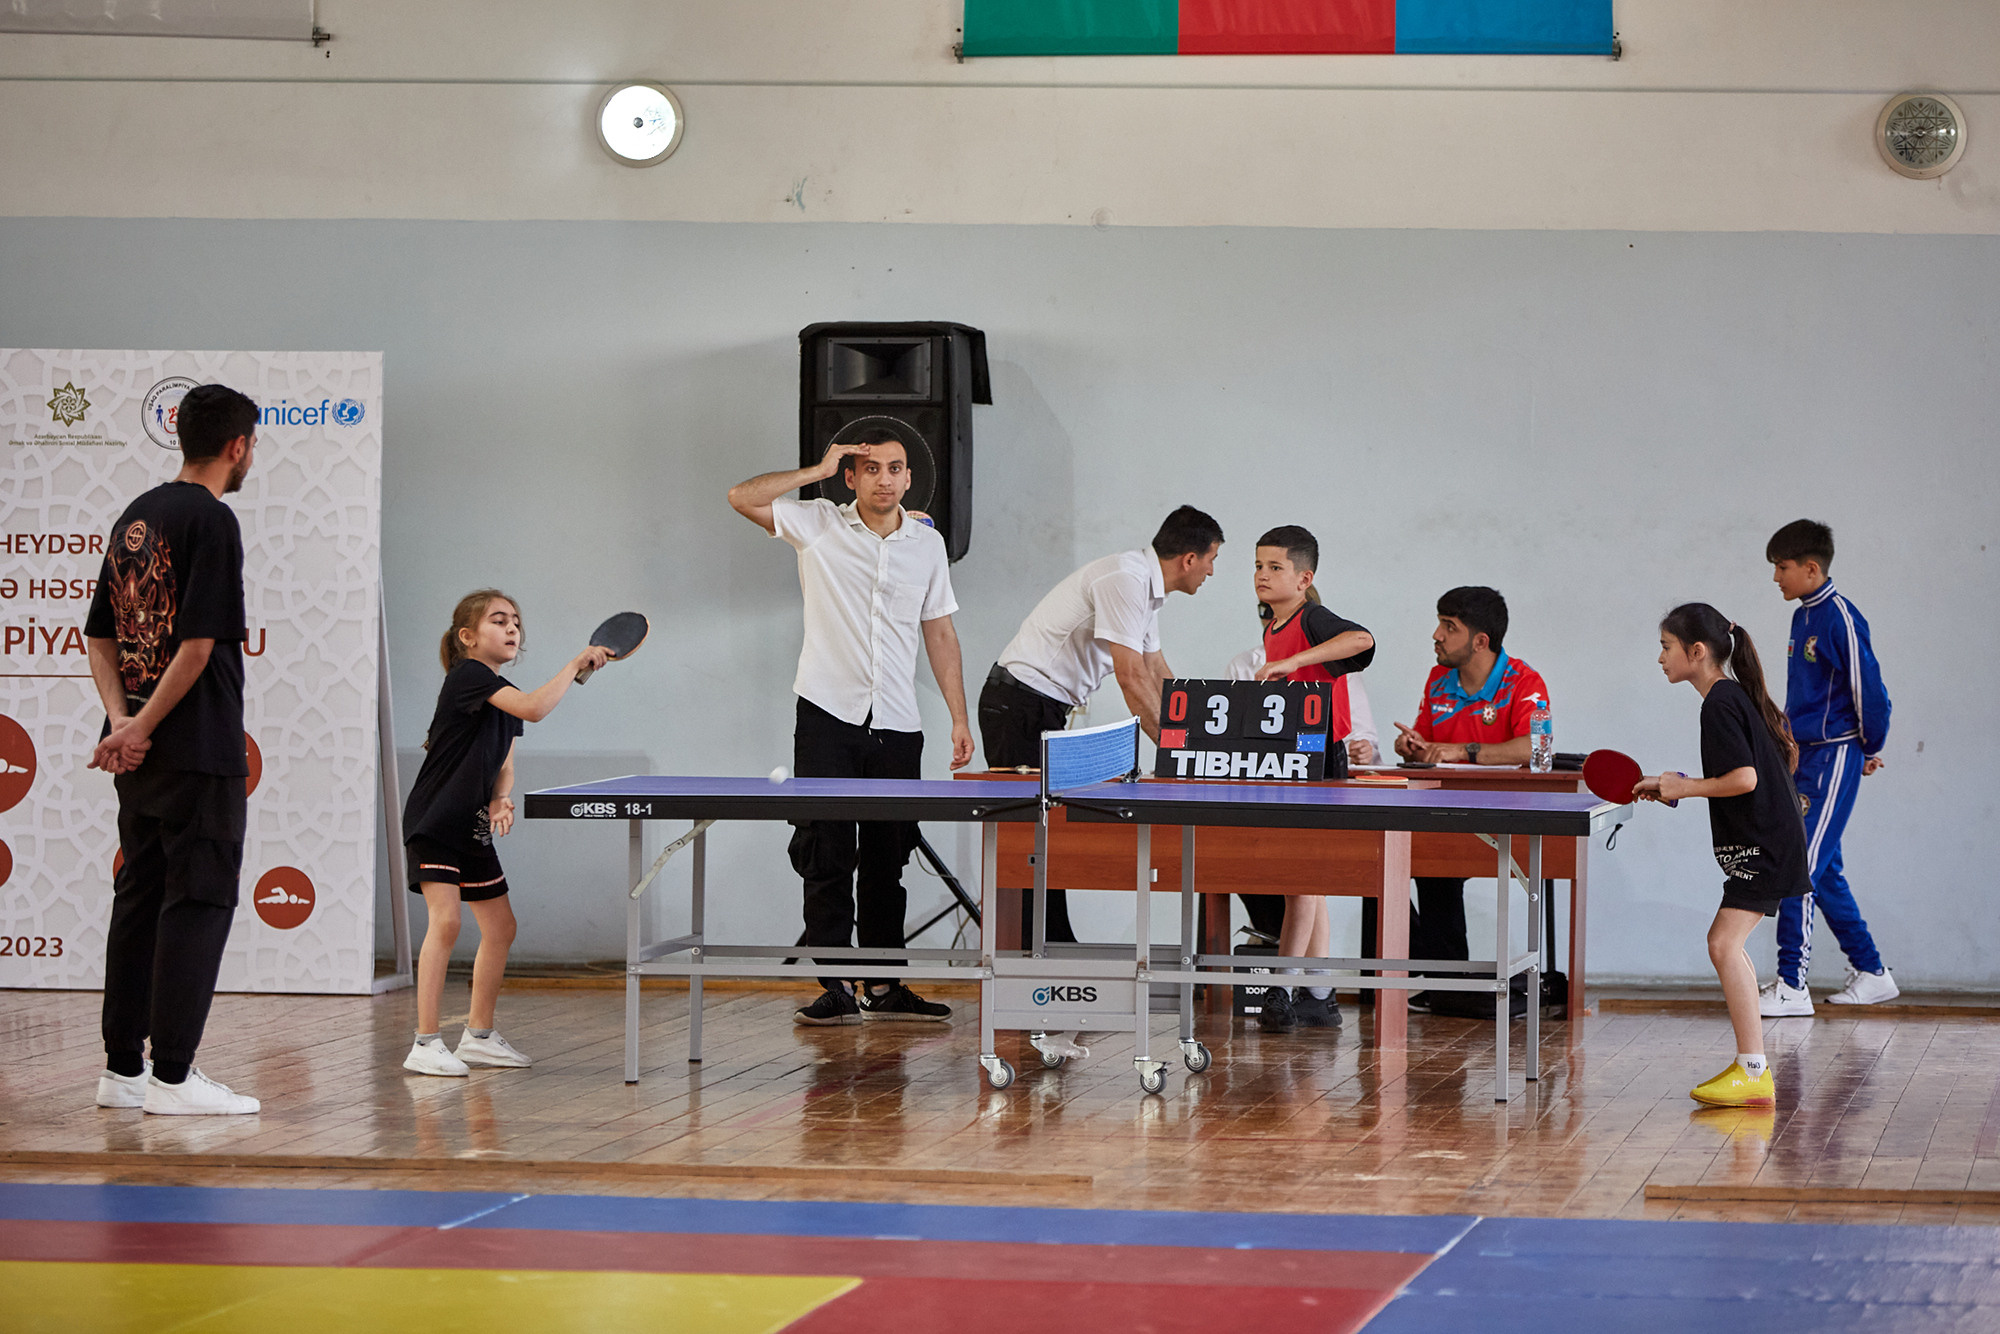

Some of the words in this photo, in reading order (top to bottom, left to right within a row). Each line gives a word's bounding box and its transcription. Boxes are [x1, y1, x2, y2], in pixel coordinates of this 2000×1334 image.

[0, 533, 104, 555] HEYDƏR
[0, 578, 19, 599] Ə
[4, 617, 88, 656] PİYA
[1168, 690, 1188, 722] 0
[1204, 694, 1230, 735] 3
[1260, 694, 1286, 735] 3
[1303, 694, 1322, 726] 0
[1170, 750, 1309, 779] TIBHAR
[583, 802, 617, 815] KBS
[624, 803, 652, 815] 18-1
[0, 936, 64, 958] 2023
[1050, 985, 1098, 1003] KBS
